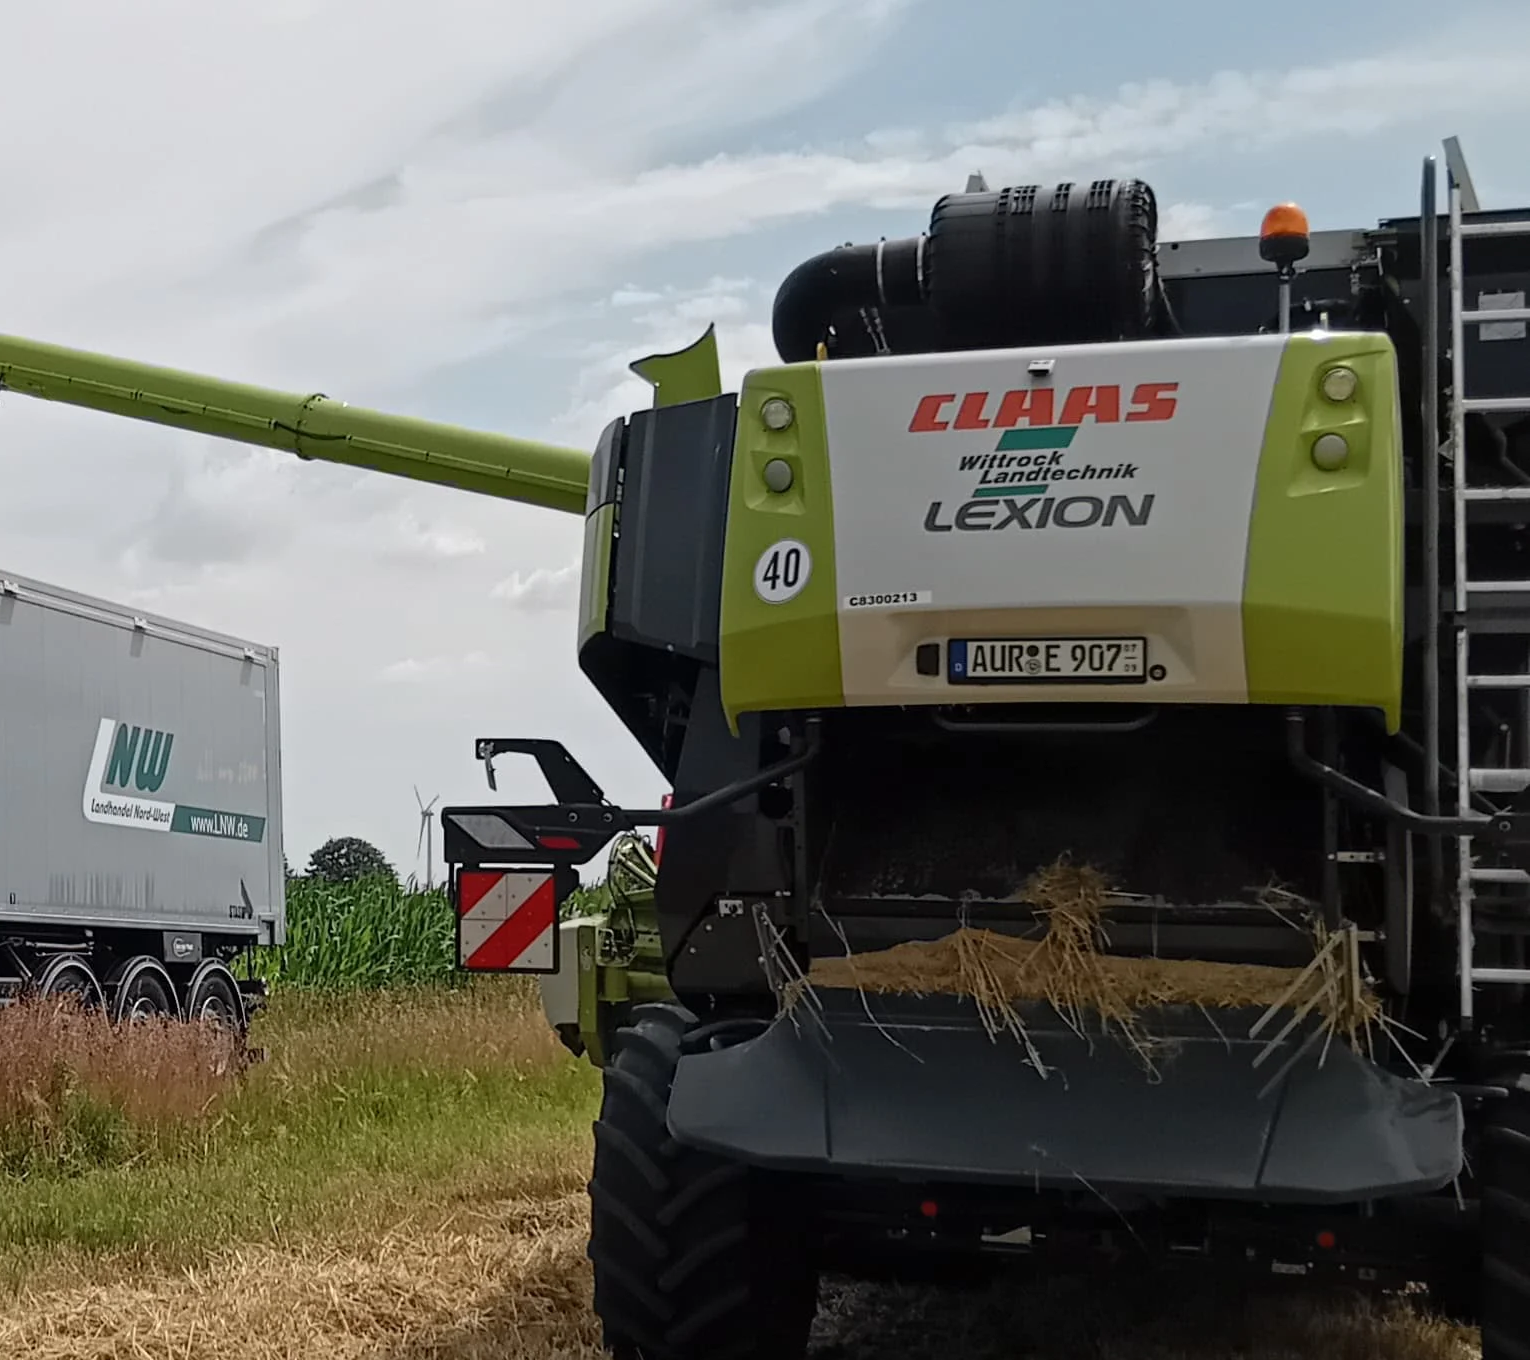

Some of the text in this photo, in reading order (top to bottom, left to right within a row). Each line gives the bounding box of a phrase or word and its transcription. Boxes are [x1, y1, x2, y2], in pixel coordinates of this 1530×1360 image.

[908, 382, 1179, 433] CLAAS
[958, 450, 1065, 471] Wittrock
[978, 463, 1140, 485] Landtechnik
[923, 494, 1156, 533] LEXION
[762, 548, 801, 590] 40
[849, 593, 918, 607] C8300213
[972, 644, 1122, 673] AUR E 907
[91, 798, 171, 824] Landhandel Nord-West
[190, 813, 249, 838] www.LNW.de
